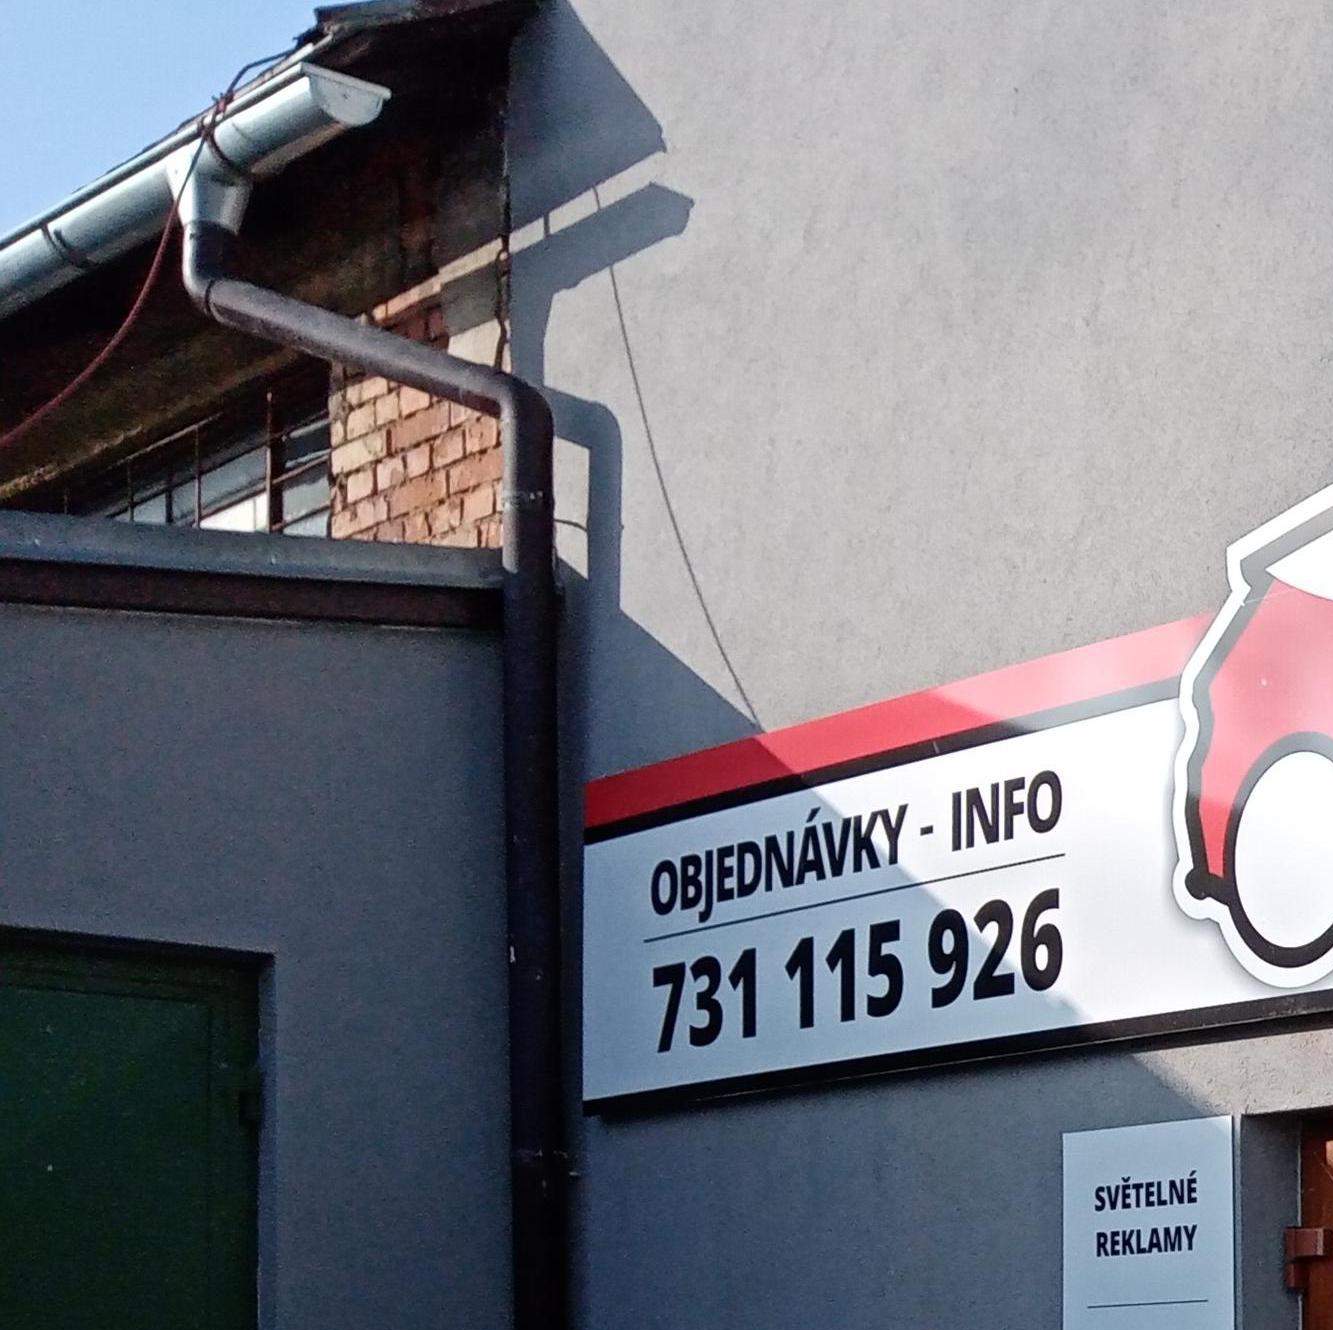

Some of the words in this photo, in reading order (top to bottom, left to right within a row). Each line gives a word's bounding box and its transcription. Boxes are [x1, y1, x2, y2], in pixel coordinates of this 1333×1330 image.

[651, 804, 908, 921] OBJEDNÁVKY
[920, 826, 934, 836] -
[951, 770, 1062, 851] INFO
[653, 947, 757, 1053] 731
[785, 919, 902, 1029] 115
[928, 888, 1063, 1008] 926
[1094, 1170, 1198, 1212] SVĚTELNÉ
[1096, 1224, 1198, 1257] REKLAMY
